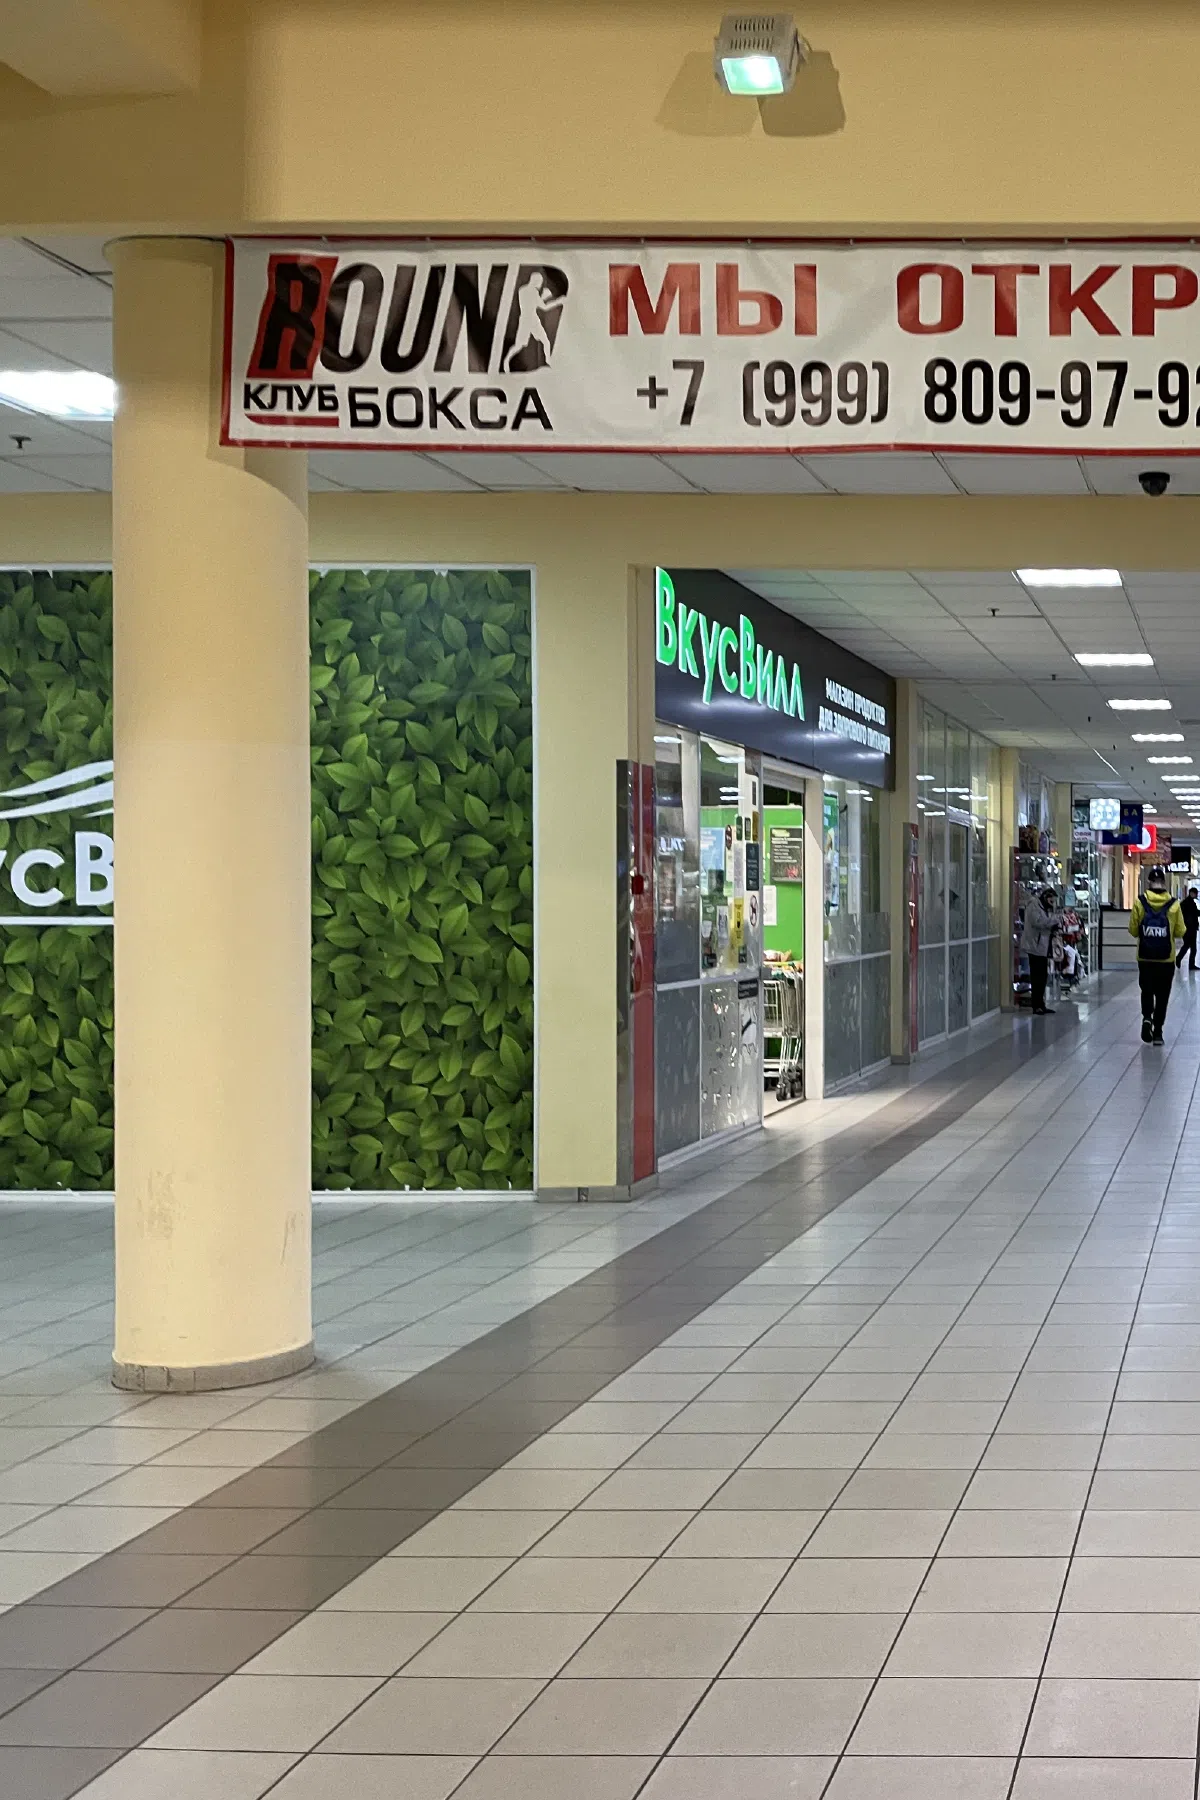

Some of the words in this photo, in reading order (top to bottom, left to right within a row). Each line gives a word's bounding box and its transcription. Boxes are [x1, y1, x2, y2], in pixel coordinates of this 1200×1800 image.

[257, 262, 570, 375] ROUND
[608, 262, 817, 337] МЫ
[242, 384, 339, 412] КЛУБ
[348, 387, 554, 431] БОКСА
[635, 358, 706, 427] +7
[742, 360, 889, 428] (999)
[1142, 925, 1168, 938] VANS
